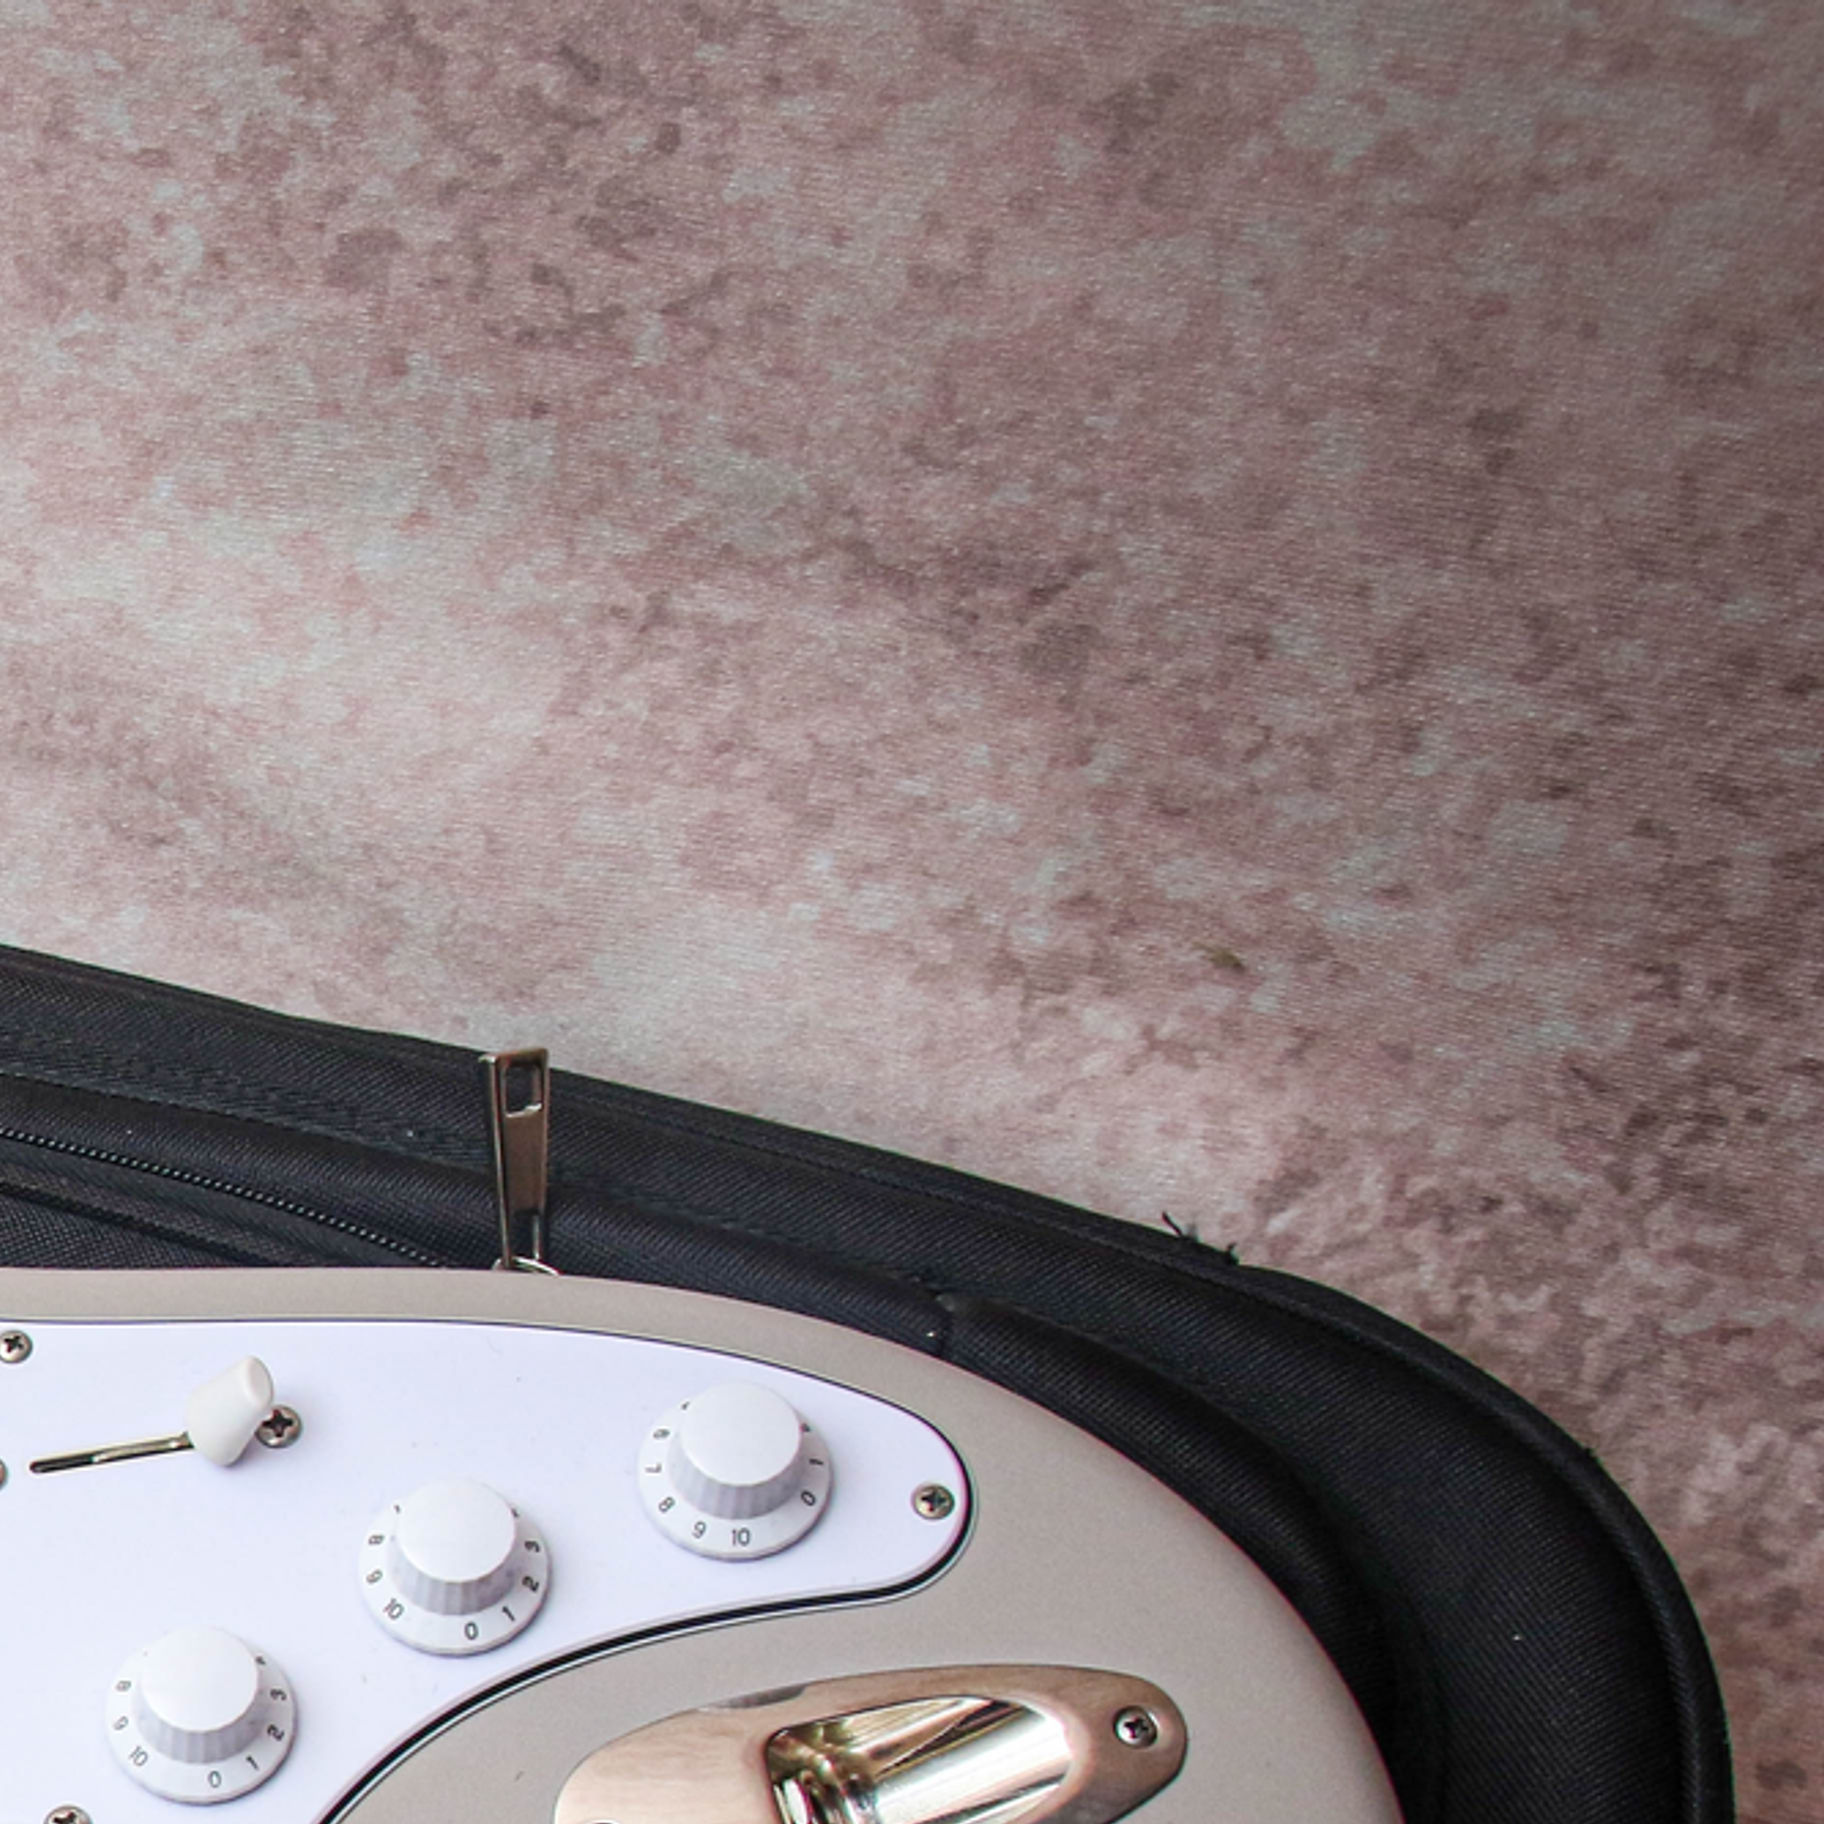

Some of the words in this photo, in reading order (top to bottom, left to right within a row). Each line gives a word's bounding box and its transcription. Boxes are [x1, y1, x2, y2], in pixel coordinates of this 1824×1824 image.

[658, 1497, 675, 1513] 8
[692, 1521, 707, 1539] 9
[732, 1528, 751, 1547] 10
[801, 1491, 816, 1506] 0
[809, 1457, 824, 1466] 1
[524, 1540, 541, 1552] 3
[366, 1569, 383, 1584] 9
[522, 1576, 540, 1592] 2
[383, 1598, 404, 1620] 10
[502, 1605, 516, 1622] 1
[464, 1622, 479, 1640] 0
[270, 1688, 287, 1701] 3
[113, 1716, 129, 1731] 9
[267, 1724, 285, 1741] 2
[128, 1746, 149, 1767] 10
[246, 1755, 260, 1771] 1
[207, 1770, 222, 1788] 0
